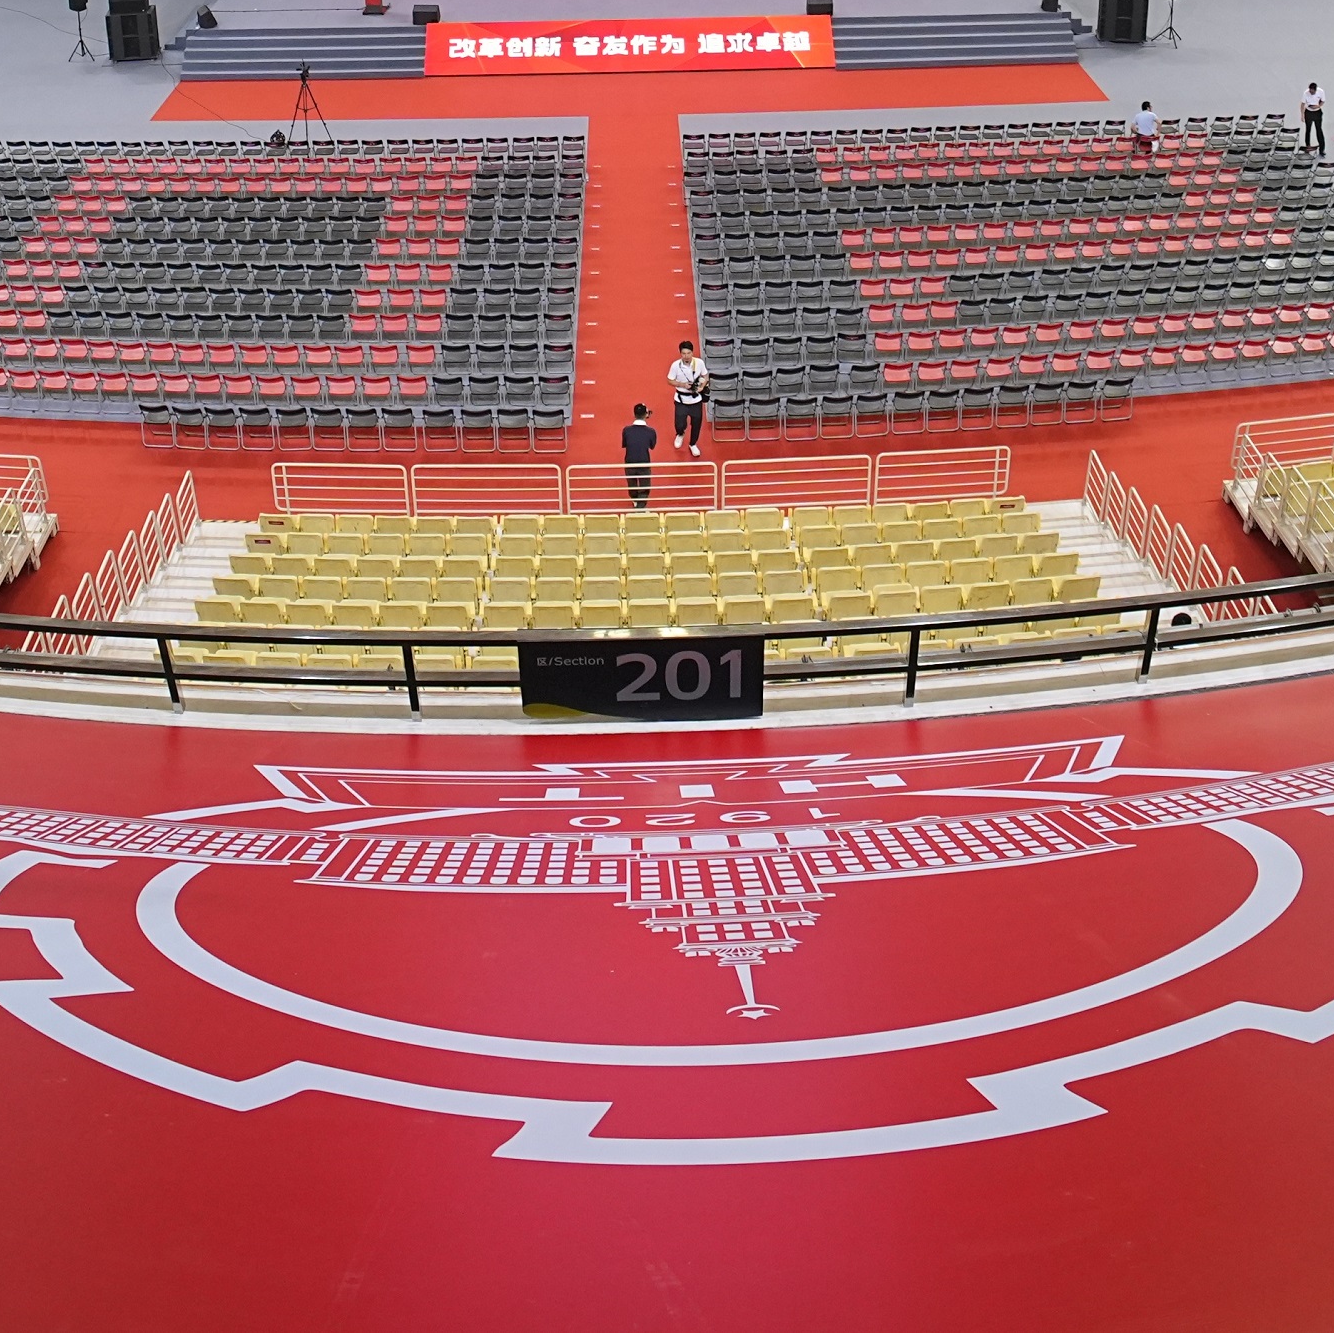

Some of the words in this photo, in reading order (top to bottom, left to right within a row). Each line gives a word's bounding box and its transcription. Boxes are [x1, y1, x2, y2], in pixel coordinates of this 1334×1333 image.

[448, 36, 562, 59] 改革创新
[573, 33, 685, 56] 奋发作为
[697, 31, 811, 54] 追求卓越
[536, 656, 605, 667] 区/Section
[617, 649, 742, 702] 201
[568, 805, 842, 829] 1920
